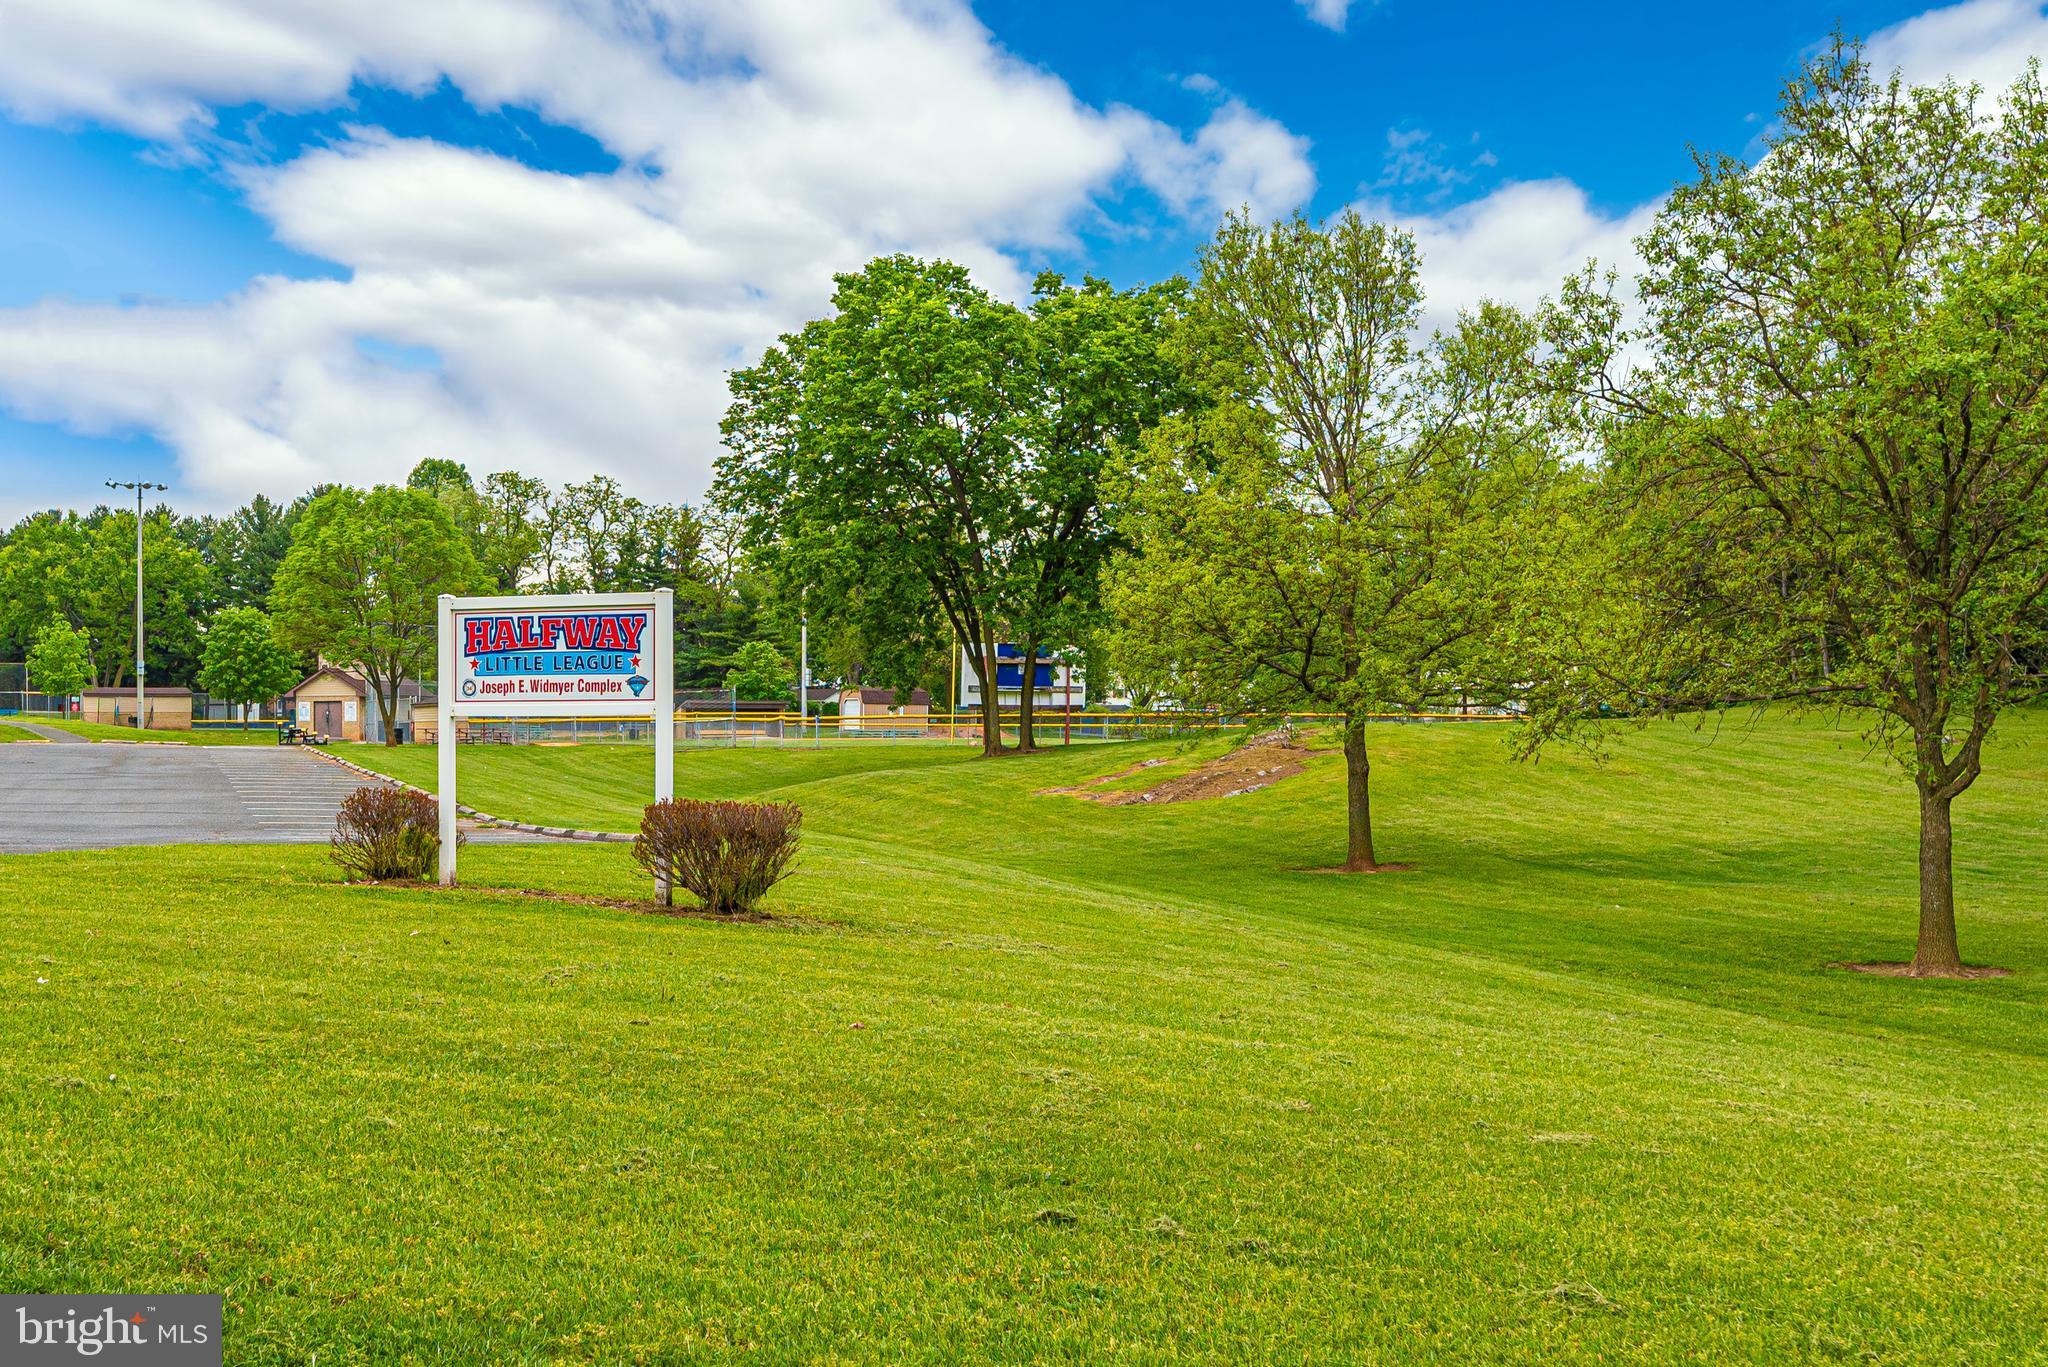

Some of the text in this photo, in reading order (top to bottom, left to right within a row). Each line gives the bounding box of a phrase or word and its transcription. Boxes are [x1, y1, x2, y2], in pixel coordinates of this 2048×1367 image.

[465, 615, 647, 655] HALFWAY
[485, 654, 624, 672] LITTLE LEAGUE
[479, 678, 623, 697] Joseph E. Widmyer Complex
